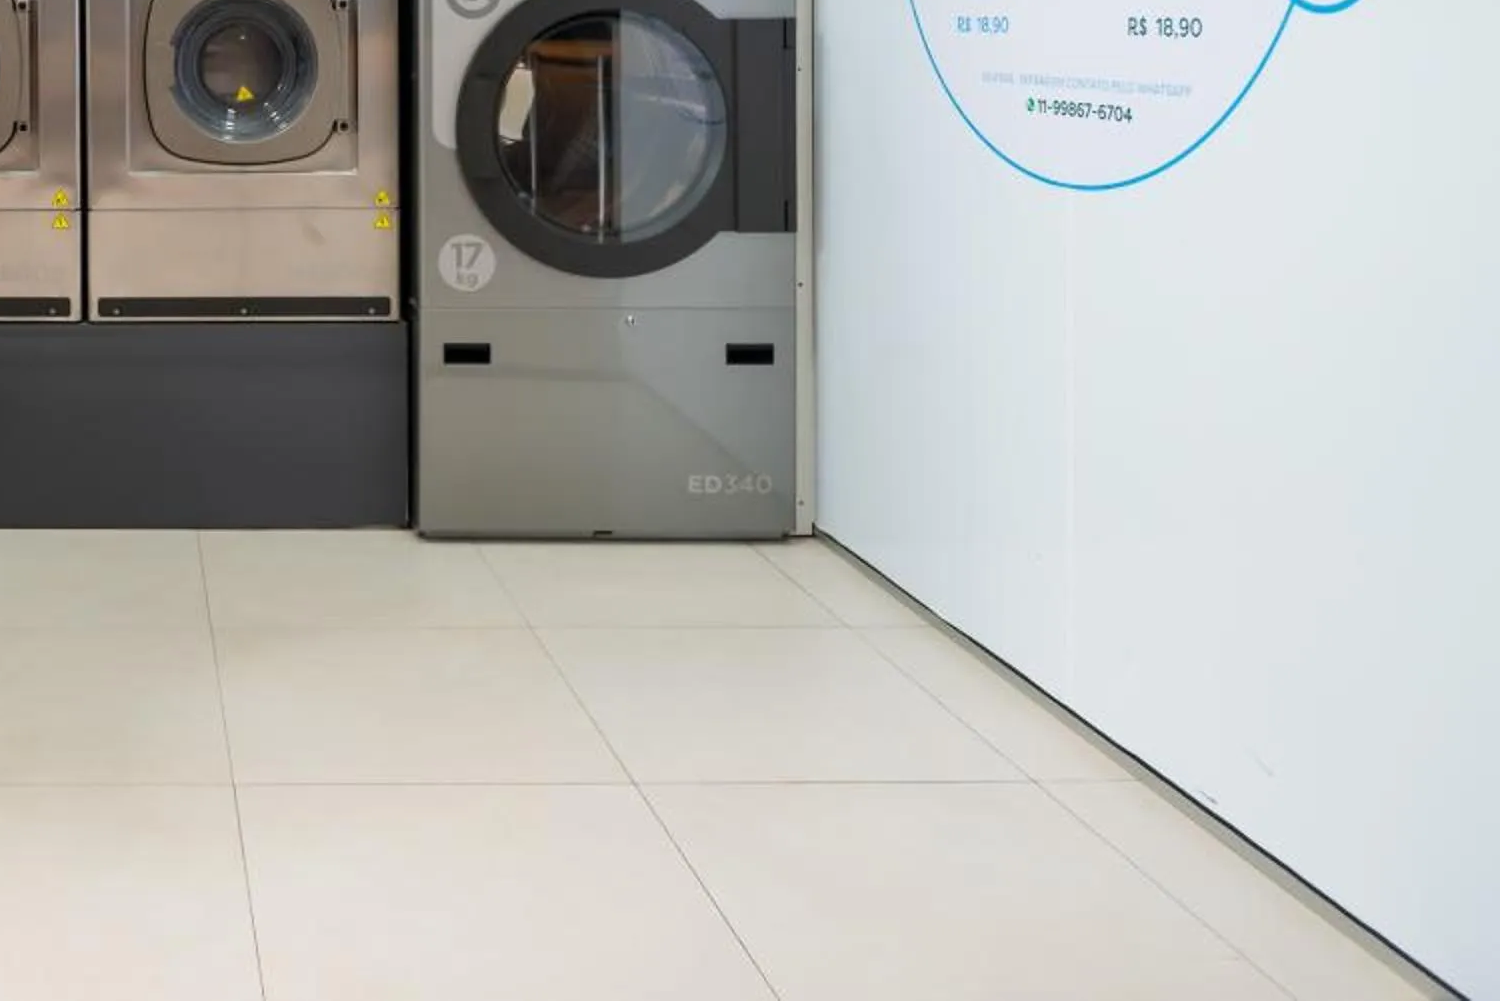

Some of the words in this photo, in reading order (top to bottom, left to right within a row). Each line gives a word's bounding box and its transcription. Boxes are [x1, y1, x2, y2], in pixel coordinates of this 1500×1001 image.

[1127, 15, 1148, 36] R$
[1155, 17, 1203, 38] 18,90
[450, 241, 483, 269] 17
[456, 269, 479, 289] kg
[688, 475, 772, 495] ED340
